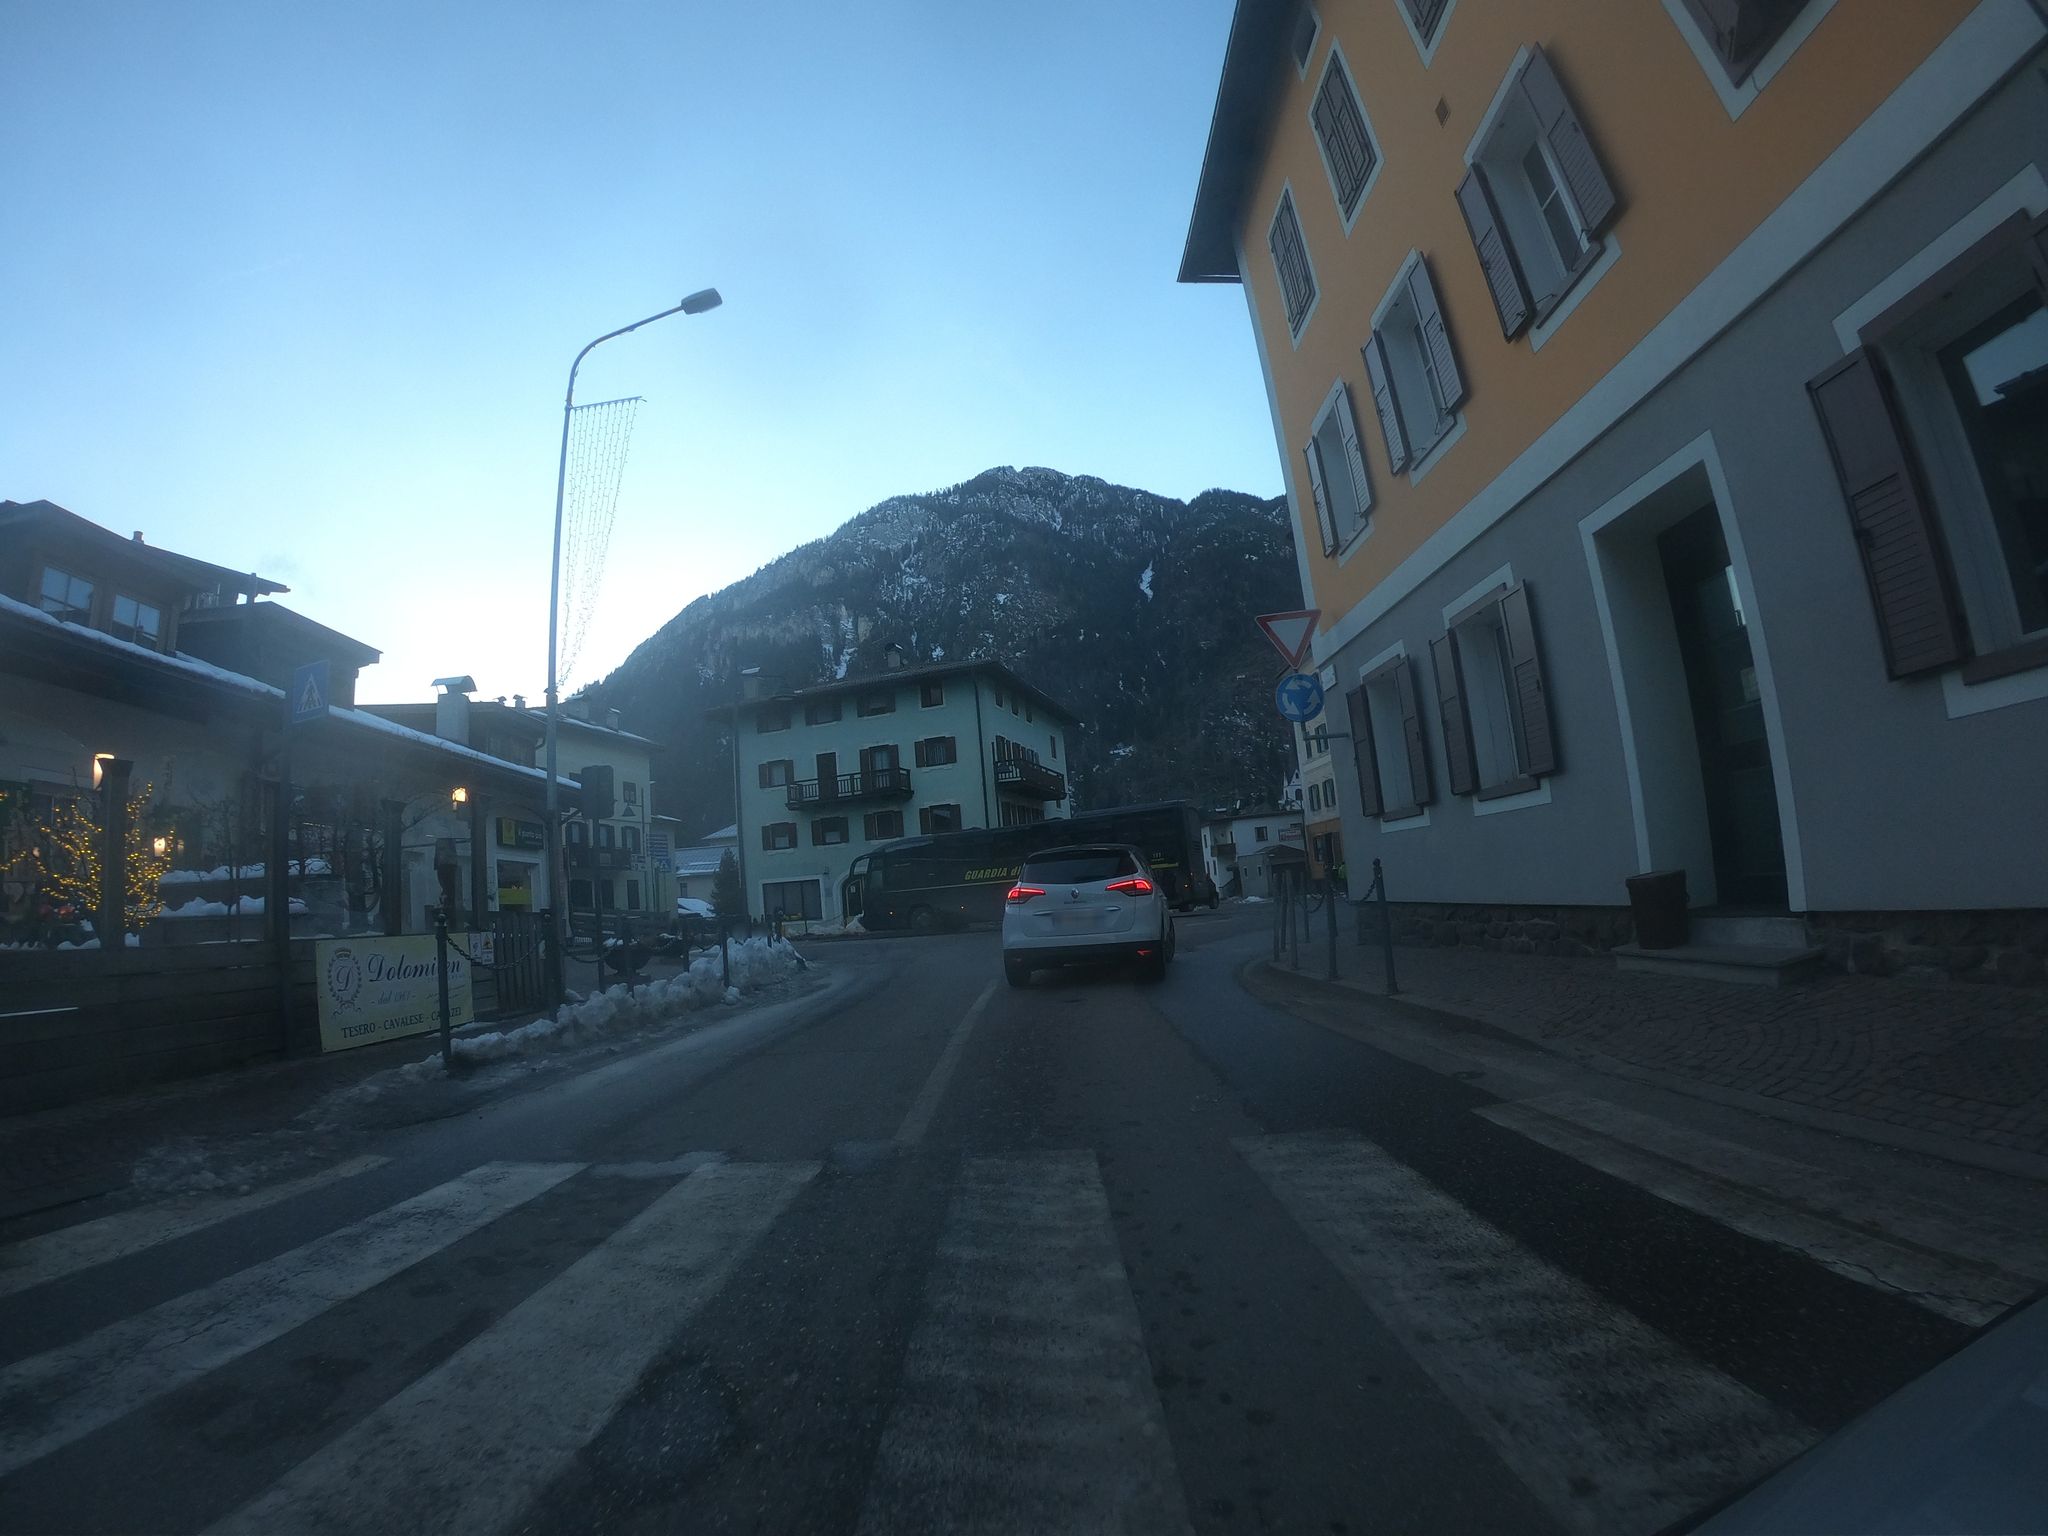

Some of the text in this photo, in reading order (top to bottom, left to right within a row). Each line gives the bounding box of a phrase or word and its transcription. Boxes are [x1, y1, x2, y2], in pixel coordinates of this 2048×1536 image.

[964, 867, 1008, 881] GUARDIA
[367, 953, 462, 982] Dolomien
[341, 1023, 376, 1039] TESERO
[383, 1013, 424, 1031] CAVALESE
